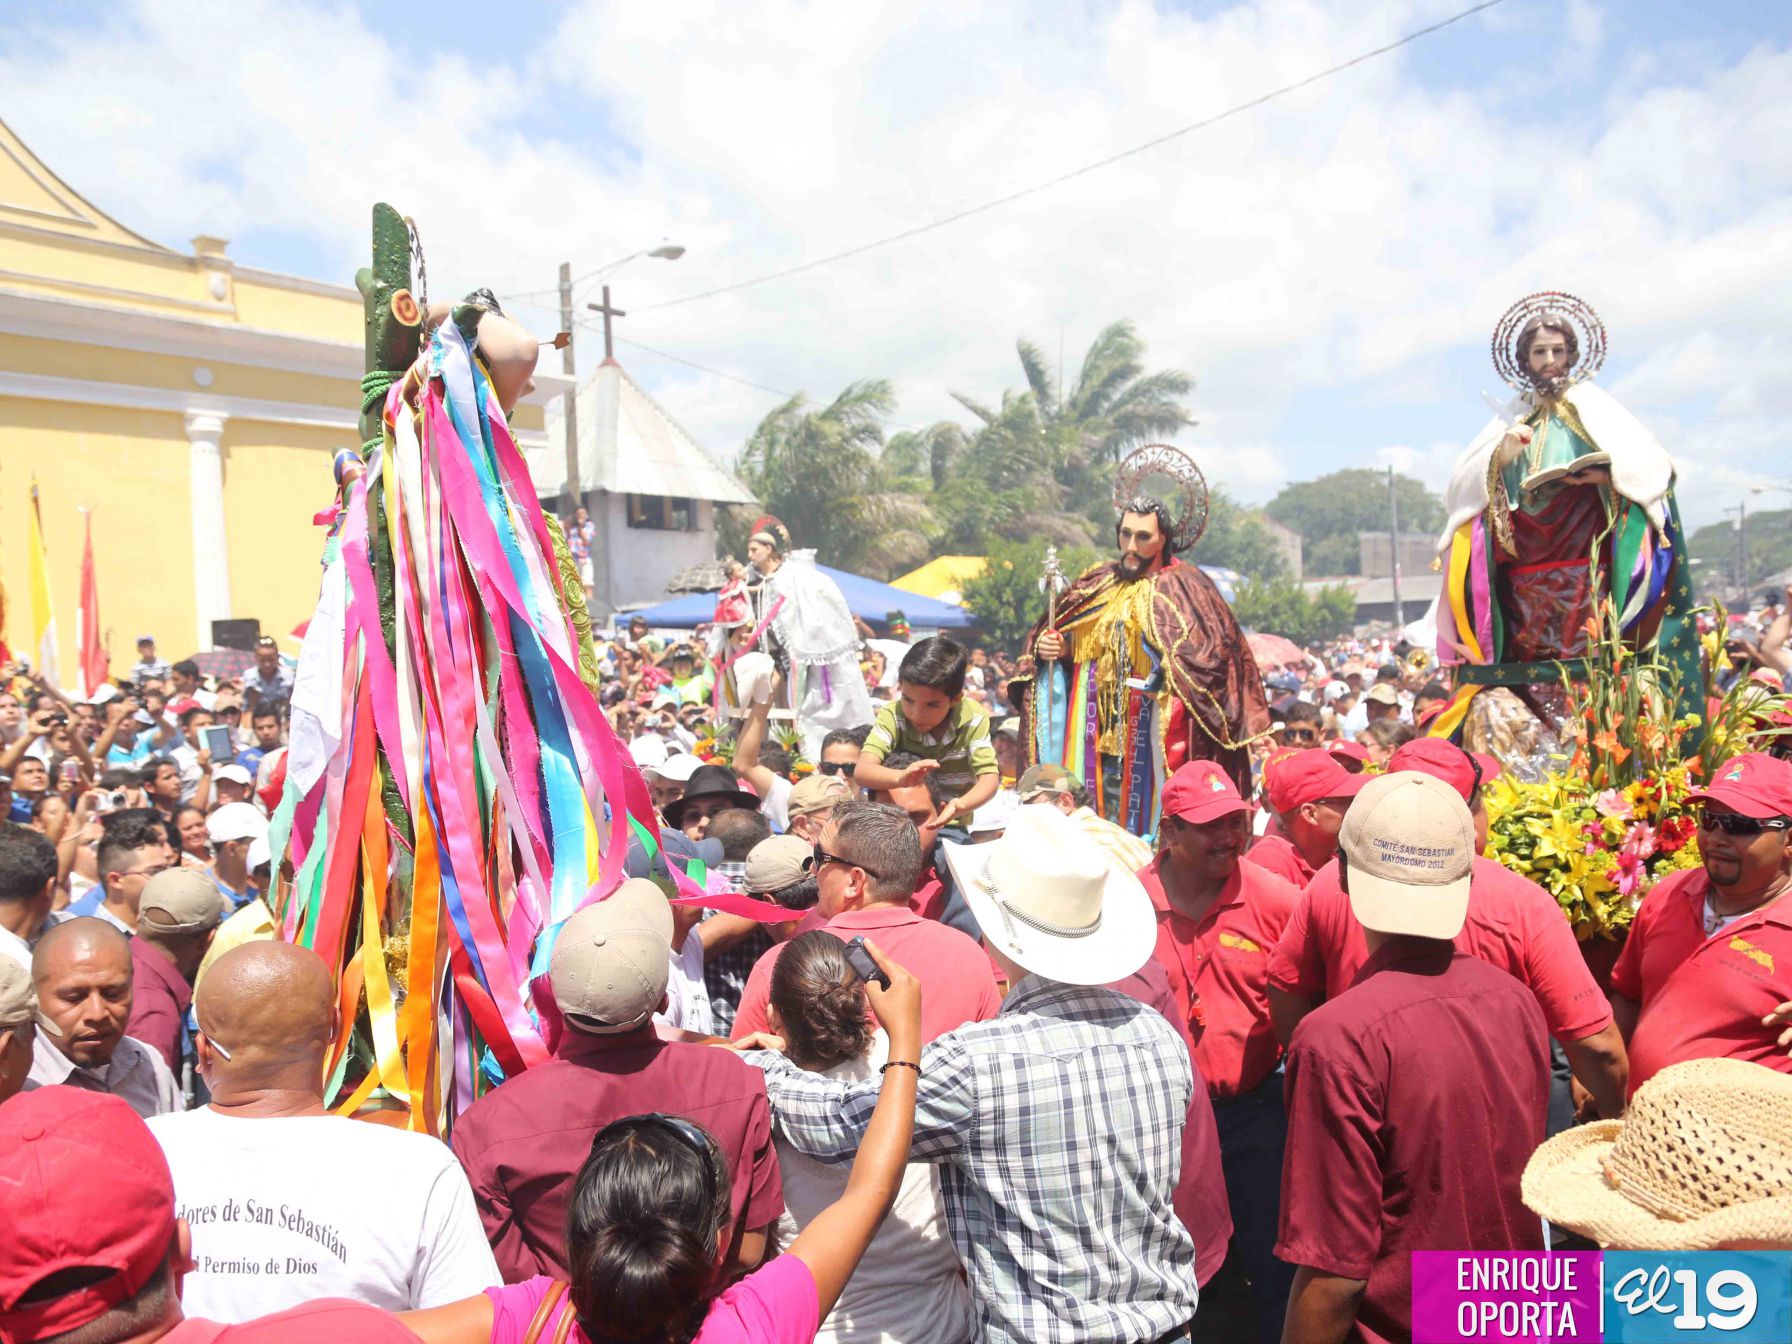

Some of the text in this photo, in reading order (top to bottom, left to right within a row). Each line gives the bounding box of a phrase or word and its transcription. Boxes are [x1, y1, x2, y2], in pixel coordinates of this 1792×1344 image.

[1400, 845, 1415, 855] SAN
[1381, 852, 1445, 869] MAYORDOMO 2012
[222, 1198, 240, 1222] de
[245, 1198, 273, 1225] San
[278, 1203, 347, 1264] Sebastián
[204, 1256, 260, 1275] Permiso
[265, 1257, 280, 1275] de
[285, 1257, 318, 1275] Dios
